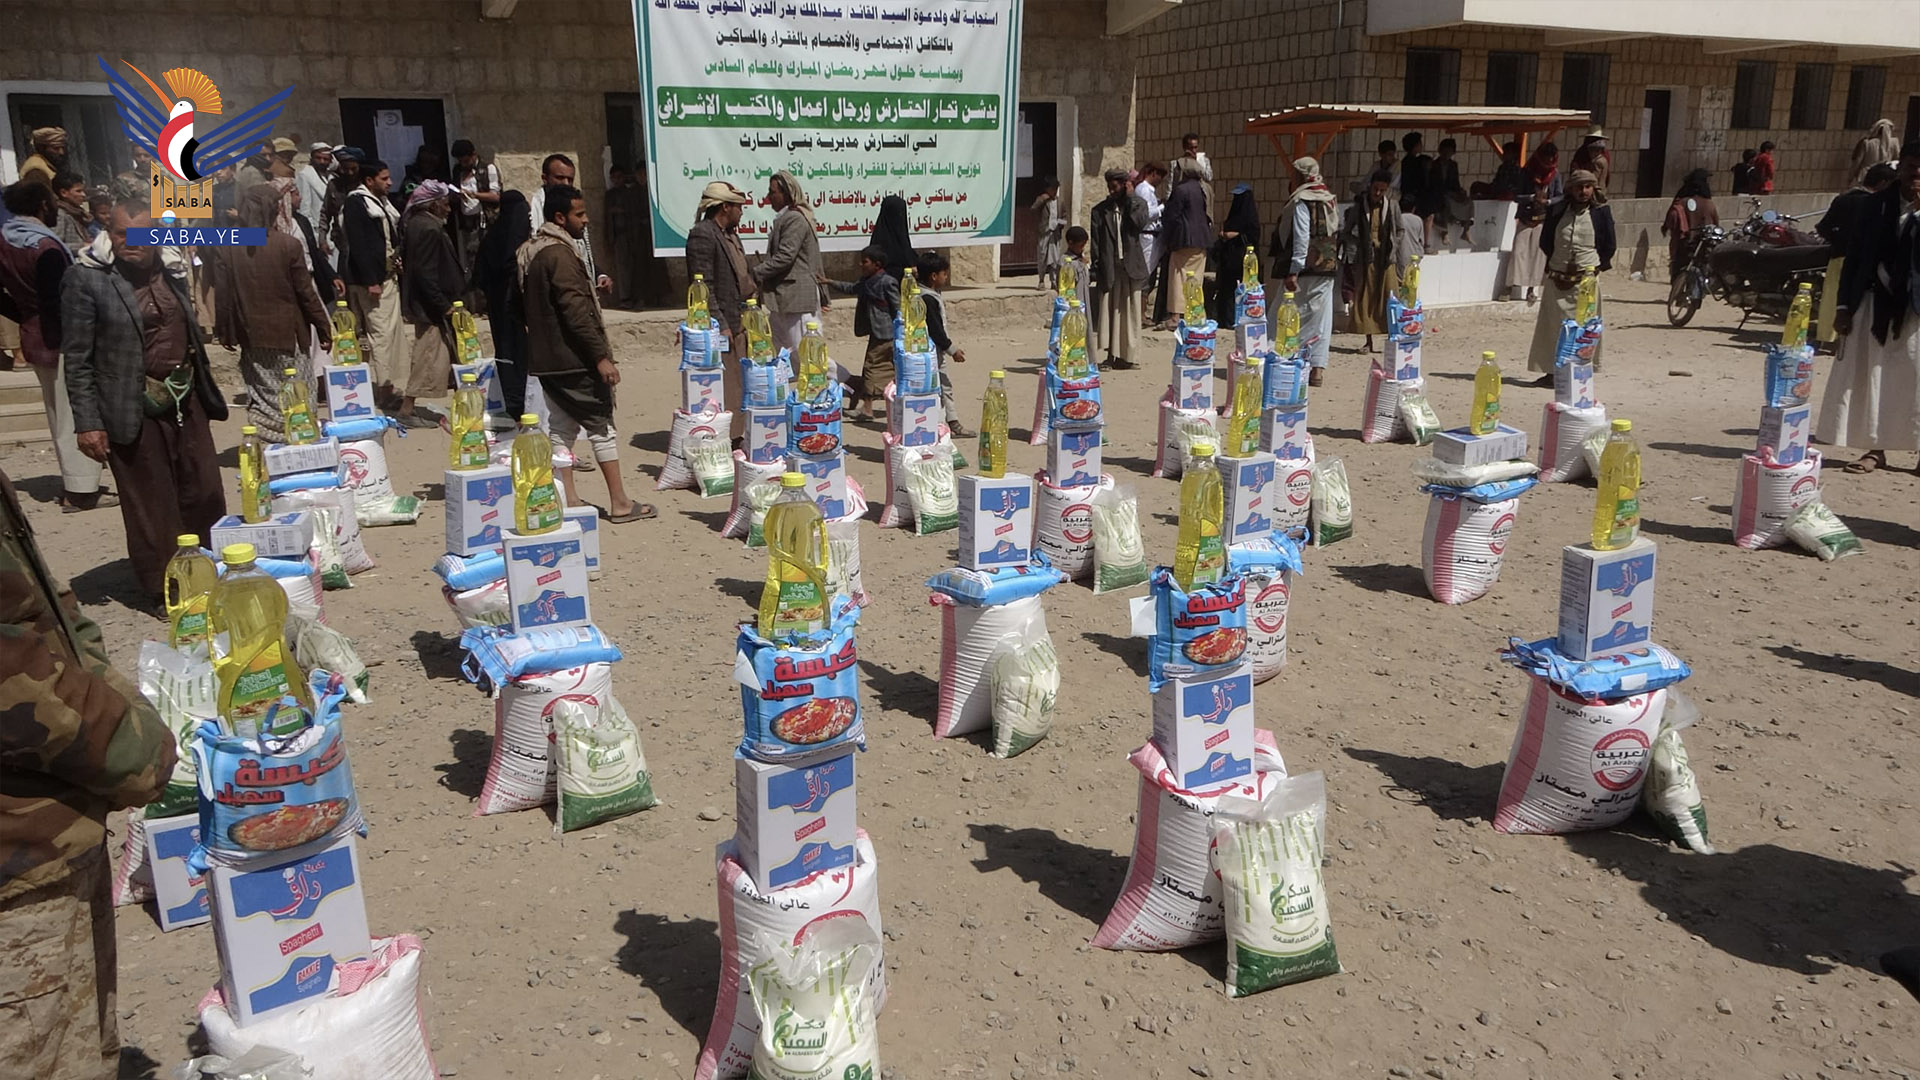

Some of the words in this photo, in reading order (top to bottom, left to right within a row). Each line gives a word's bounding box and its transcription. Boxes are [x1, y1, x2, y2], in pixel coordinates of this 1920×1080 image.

[749, 0, 776, 18] الدين
[779, 0, 796, 19] بدر
[881, 7, 911, 24] السيد
[913, 8, 948, 27] ولدعوة
[949, 8, 961, 25] لله
[716, 27, 767, 47] والمساكين
[771, 29, 808, 50] بالفقراء
[916, 35, 954, 55] بالتكافل
[704, 57, 744, 76] السادس
[748, 59, 783, 78] وللعام
[786, 59, 821, 79] المبارك
[824, 61, 860, 80] رمضان
[862, 62, 887, 81] شهر
[889, 63, 915, 82] حلول
[919, 63, 964, 83] وبمناسبة
[658, 91, 721, 125] الإشرافي
[724, 93, 784, 121] والمكتب
[832, 96, 872, 123] ورجال
[876, 97, 931, 123] الحتارش
[932, 99, 959, 123] تجار
[961, 99, 997, 124] يدشن
[739, 131, 783, 152] الحارث
[786, 133, 812, 155] بني
[816, 132, 859, 152] مديرية
[864, 132, 909, 152] الحتارش
[912, 133, 938, 155] لحي
[682, 158, 713, 180] أسرة
[754, 162, 773, 180] من
[806, 160, 854, 180] والمساكين
[856, 161, 888, 180] للفقراء
[929, 161, 955, 176] السلة
[957, 161, 981, 179] توزيع
[907, 191, 922, 209] حي
[924, 187, 954, 208] ساكني
[955, 190, 968, 205] من
[834, 217, 859, 235] شهر
[913, 214, 932, 232] لكل
[959, 213, 978, 229] واحد
[773, 638, 857, 683] كبسة
[760, 679, 814, 701] سهيل
[235, 735, 347, 788] كبسة
[1595, 749, 1648, 760] العربية
[216, 782, 285, 807] سهيل
[792, 773, 831, 810] راقي
[1536, 772, 1588, 799] ممتاز
[795, 817, 826, 841] Spaghetti
[270, 871, 322, 917] راقي
[1158, 874, 1213, 904] ممتاز
[1287, 883, 1311, 904] سكر
[779, 898, 810, 912] عالي
[1278, 896, 1314, 921] السعيد
[279, 924, 321, 953] Spaghetti
[793, 1018, 826, 1035] سكر
[780, 1031, 828, 1056] السعيد
[848, 1067, 857, 1078] 5
